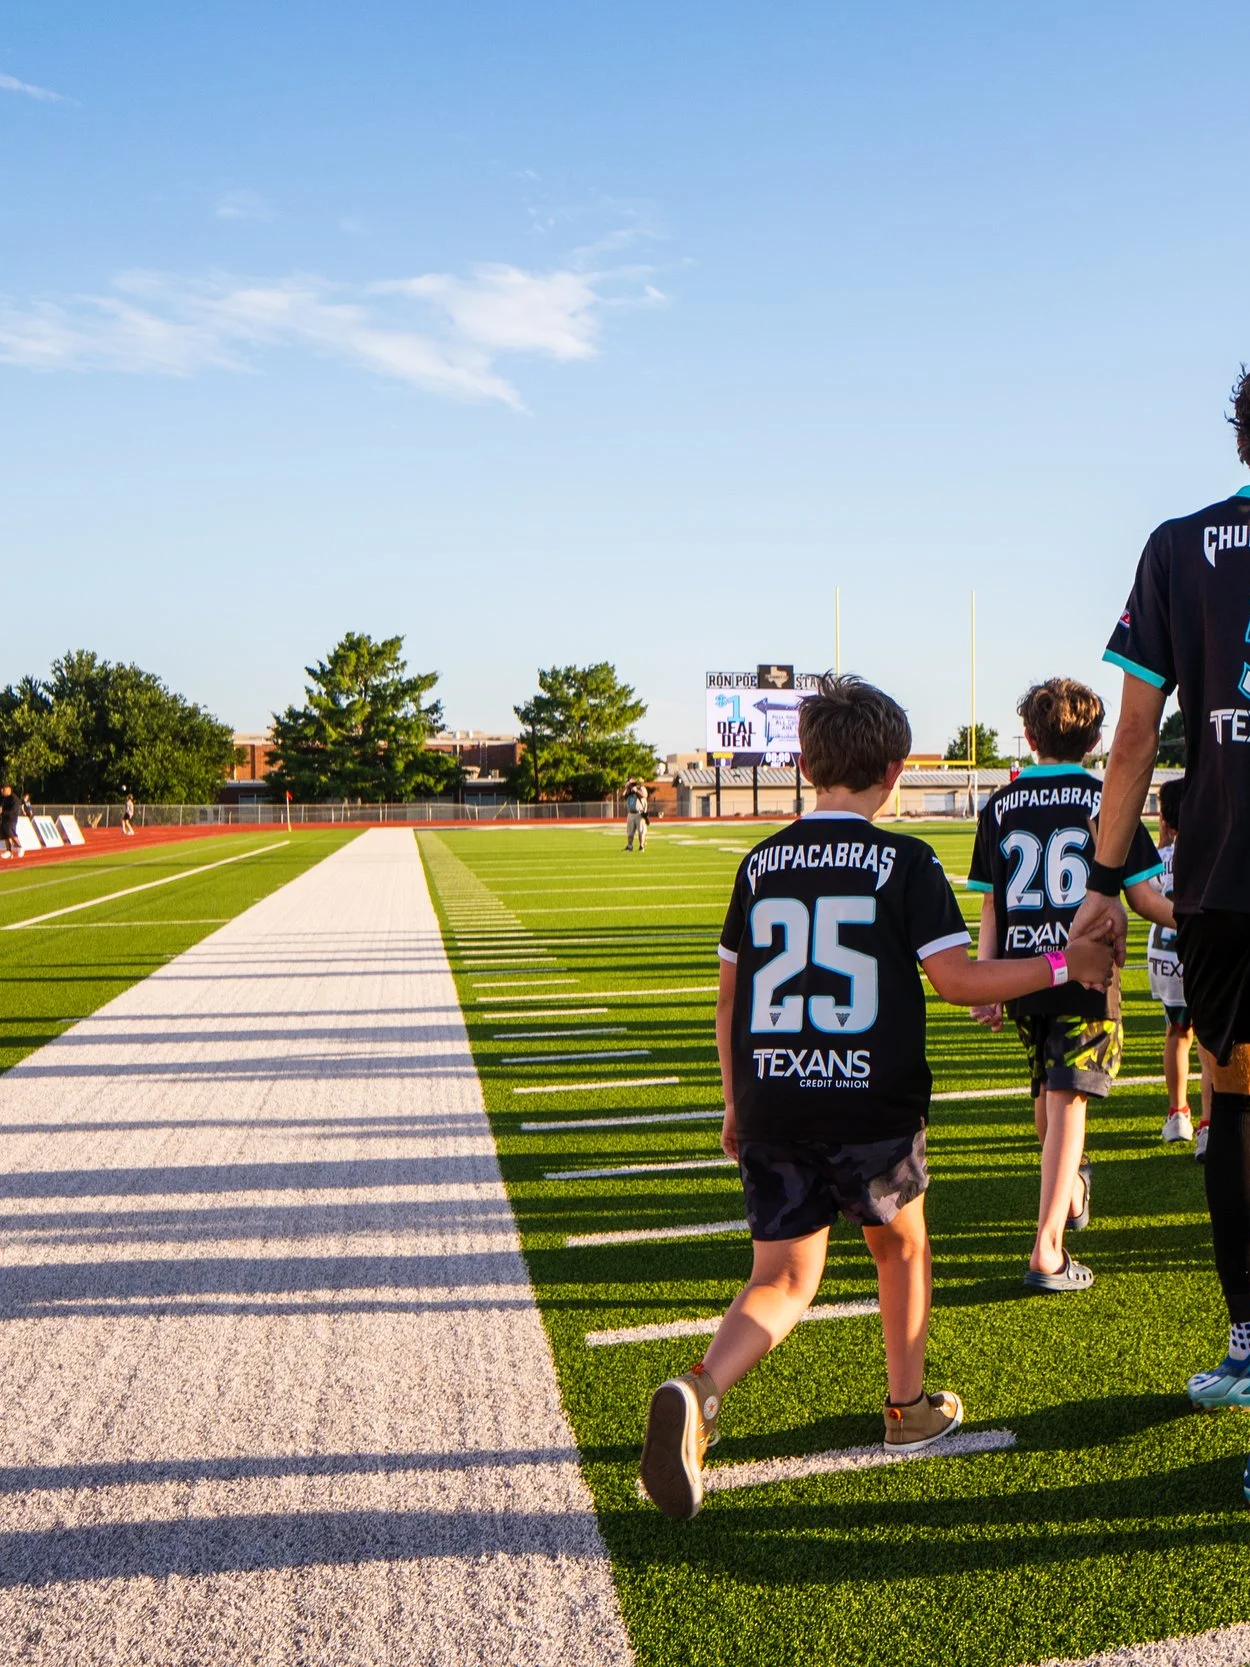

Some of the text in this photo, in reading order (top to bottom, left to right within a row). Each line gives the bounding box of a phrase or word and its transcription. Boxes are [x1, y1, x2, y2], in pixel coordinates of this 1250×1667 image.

[708, 675, 732, 687] RON
[735, 675, 757, 687] POE
[715, 694, 746, 723] $1
[717, 721, 757, 735] DEAL
[721, 734, 752, 747] DEN
[994, 787, 1101, 828] CHUPACABRAS
[746, 842, 897, 896] CHUPACABRAS
[1000, 827, 1091, 912] 26
[750, 896, 879, 1034] 25
[752, 1048, 871, 1080] TEXANS
[799, 1079, 869, 1089] CREDIT UNION
